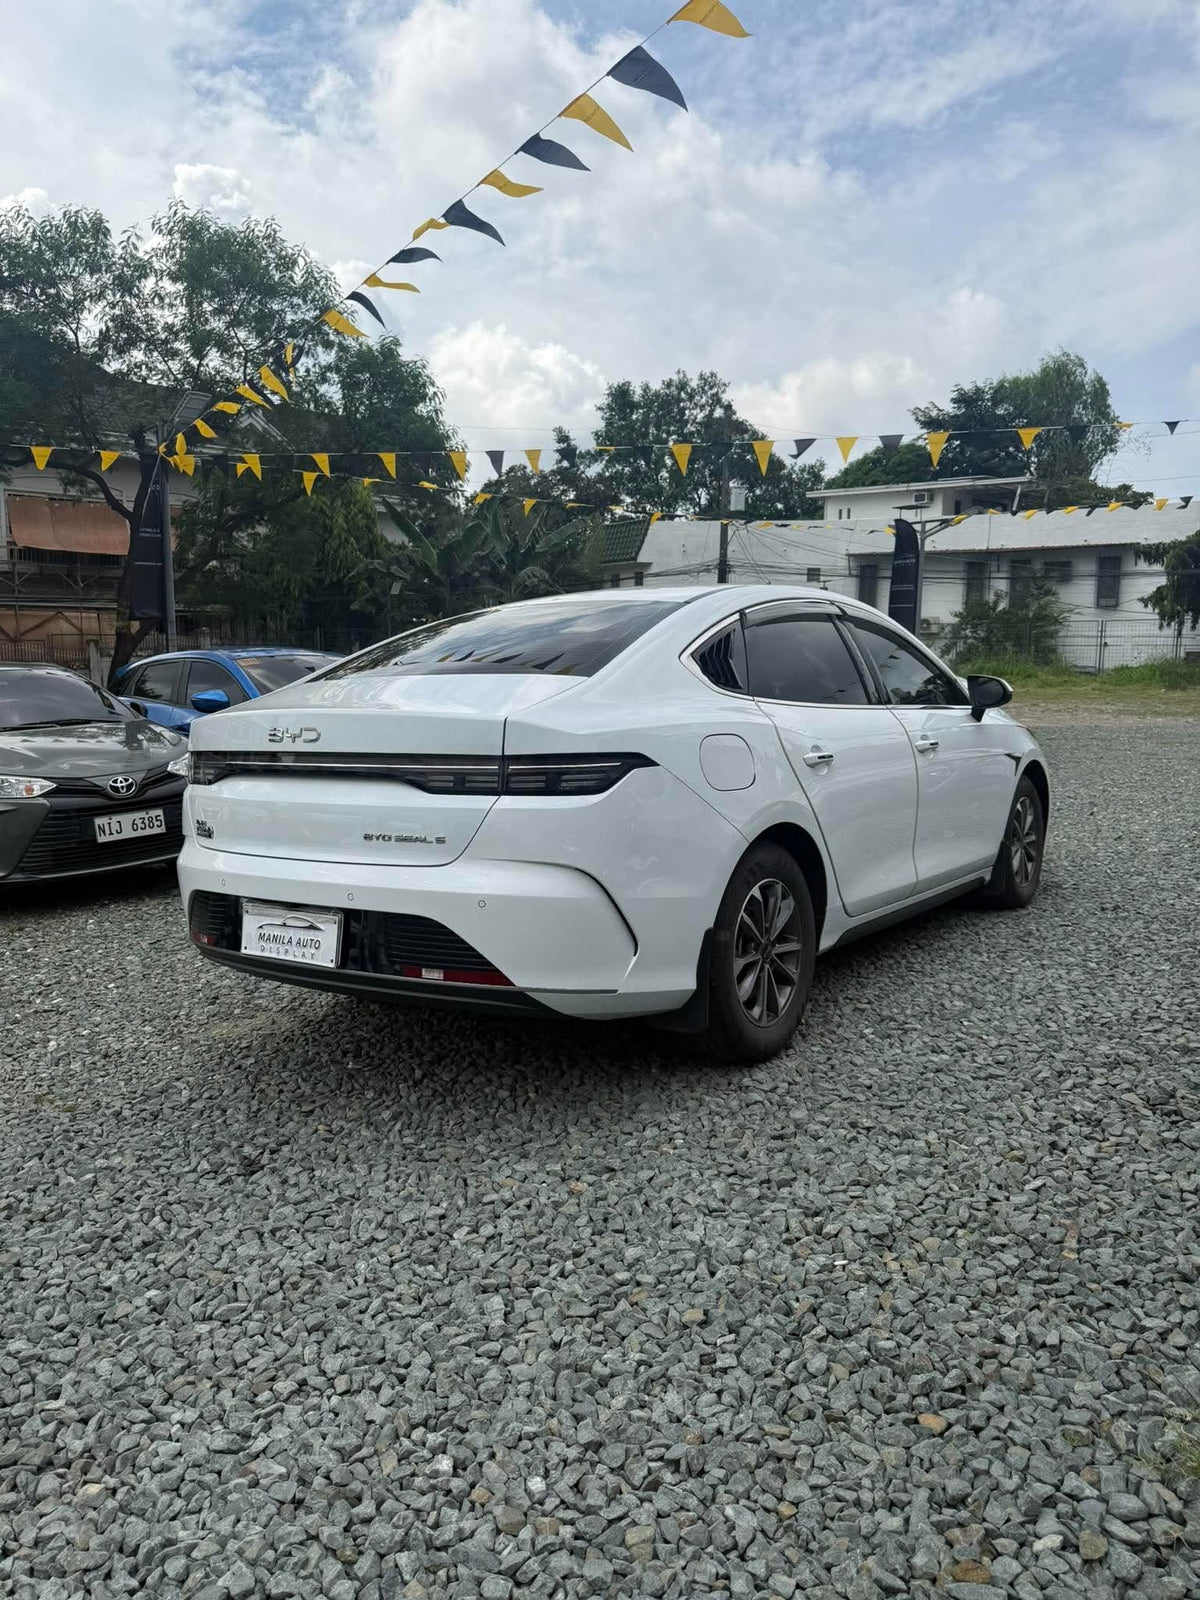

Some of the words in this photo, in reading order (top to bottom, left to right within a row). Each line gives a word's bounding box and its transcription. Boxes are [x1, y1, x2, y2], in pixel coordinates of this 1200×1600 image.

[268, 727, 321, 743] BYD
[97, 820, 122, 837] NIJ
[132, 815, 163, 832] 6385
[363, 833, 392, 842] BYD
[394, 835, 434, 844] SEAL
[257, 932, 293, 946] MANILA
[295, 937, 321, 950] AUTO
[260, 944, 316, 960] DISPLAY
